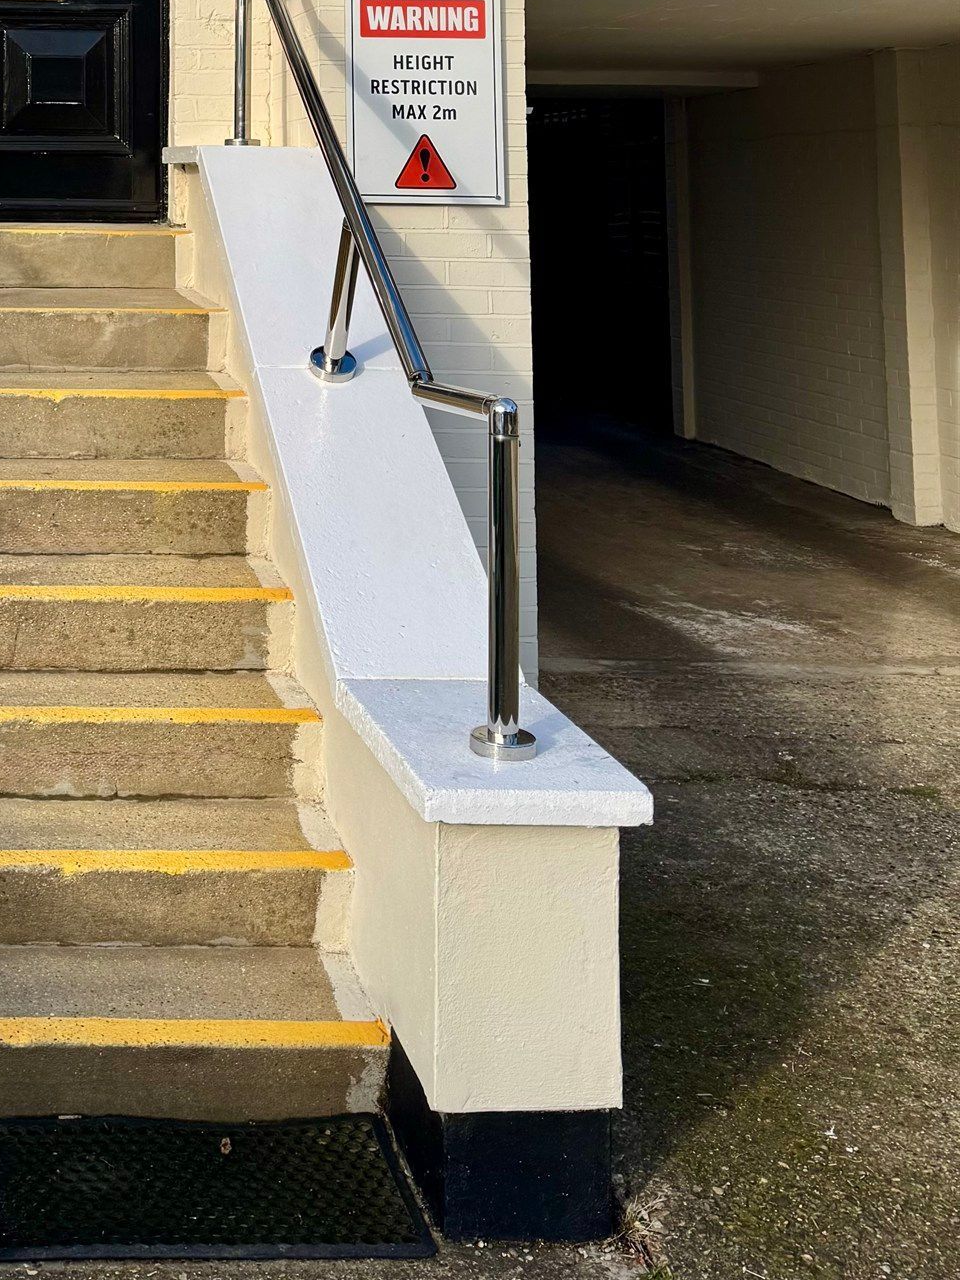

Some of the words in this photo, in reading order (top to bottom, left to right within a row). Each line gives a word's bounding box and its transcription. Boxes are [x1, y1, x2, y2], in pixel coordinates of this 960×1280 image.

[366, 5, 479, 32] WARNING
[393, 55, 454, 70] HEIGHT
[370, 79, 477, 95] RESTRICTION
[392, 104, 427, 119] MAX
[432, 105, 457, 120] 2m
